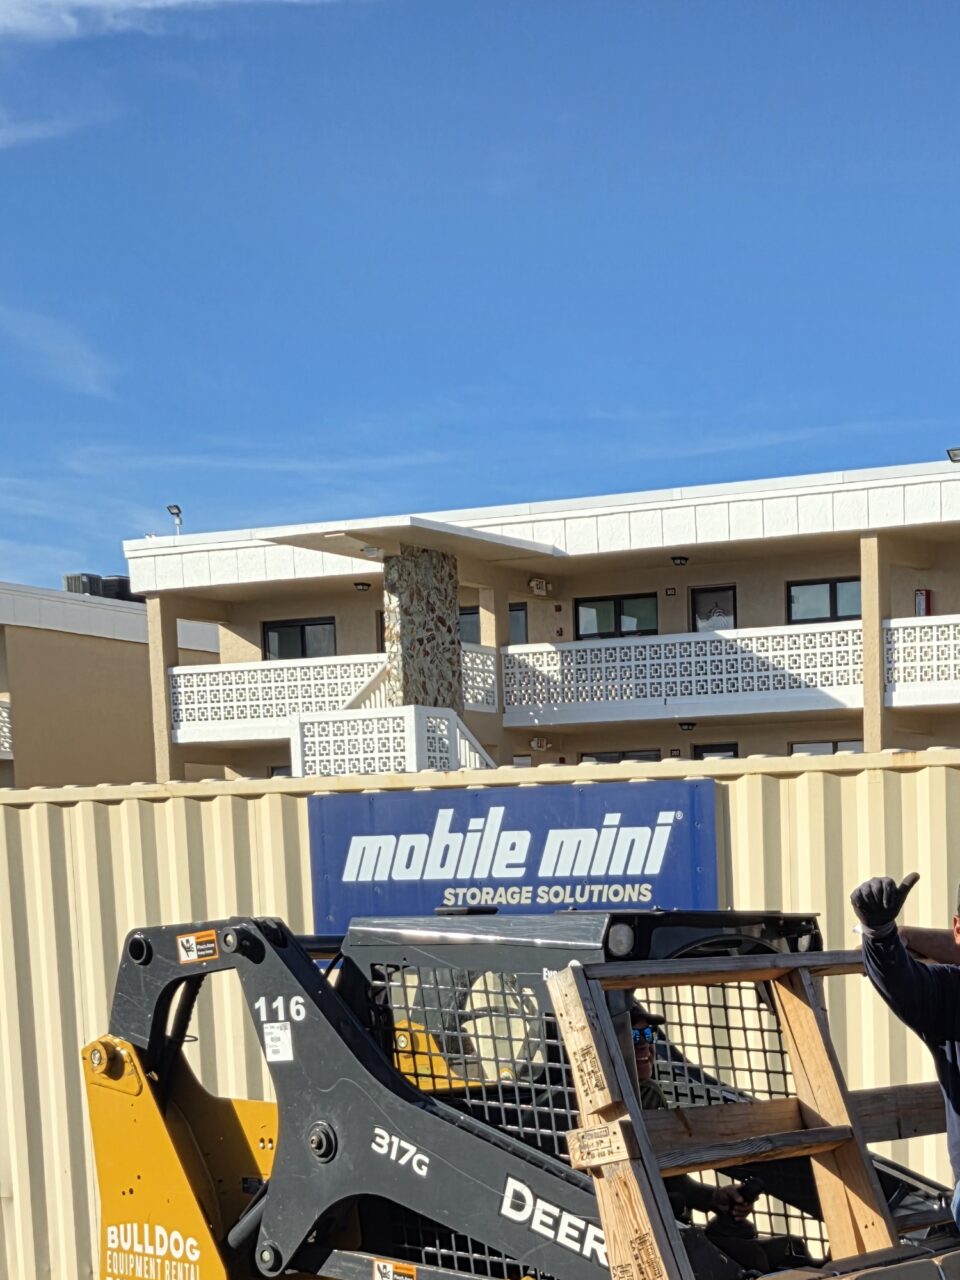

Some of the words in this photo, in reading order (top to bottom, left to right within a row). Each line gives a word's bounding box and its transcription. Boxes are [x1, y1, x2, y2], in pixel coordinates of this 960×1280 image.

[342, 806, 532, 883] mobile
[538, 811, 676, 878] mini
[443, 886, 533, 907] STORAGE
[536, 883, 653, 905] SOLUTIONS
[254, 995, 307, 1022] 116
[370, 1127, 430, 1177] 317G
[500, 1176, 608, 1267] DEER
[106, 1222, 201, 1262] BULLDOG
[106, 1250, 162, 1280] EQUIPMENT
